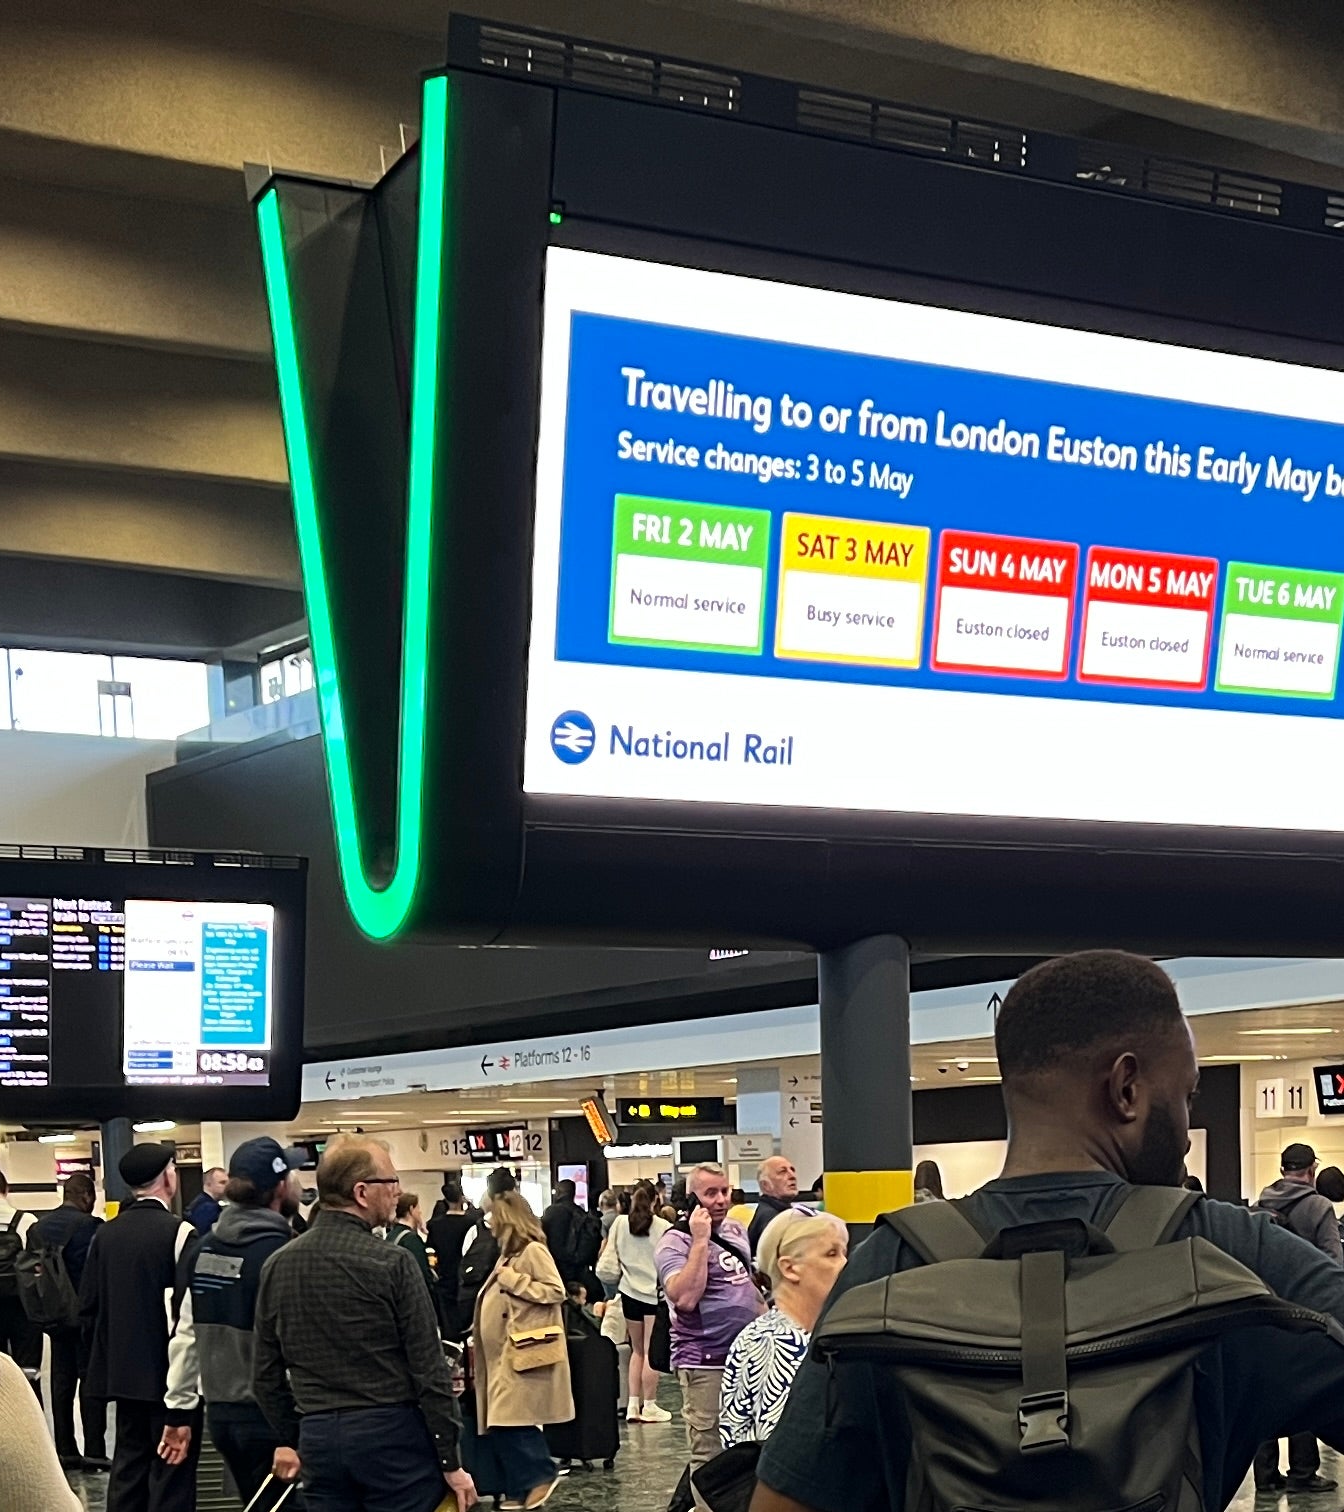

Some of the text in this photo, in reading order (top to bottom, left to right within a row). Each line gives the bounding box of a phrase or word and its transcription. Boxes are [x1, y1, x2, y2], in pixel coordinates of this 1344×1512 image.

[621, 367, 771, 433] Travelling
[781, 394, 813, 428] to
[820, 404, 852, 433] or
[858, 400, 927, 444] from
[936, 411, 1040, 458] London
[1047, 426, 1137, 471] Euston
[1145, 440, 1191, 477] this
[1197, 446, 1260, 494] Early
[1265, 456, 1322, 501] May
[618, 430, 914, 499] Service changes: 3 to 5 May
[632, 512, 754, 552] FRI 2 MAY
[797, 532, 914, 567] SAT 3 MAY
[949, 548, 1067, 584] SUN 4 MAY
[1090, 561, 1213, 598] MON 5 MAY
[630, 588, 746, 615] Normal service
[1236, 577, 1337, 610] TUE 6 MAY
[807, 605, 895, 628] Busy service
[956, 618, 1049, 641] Euston closed
[1101, 631, 1189, 653] Euston closed
[1234, 643, 1324, 664] Normal service
[610, 724, 793, 765] National Rail
[514, 1045, 591, 1069] Platforms 12 16
[1262, 1086, 1303, 1110] 11 11
[439, 1140, 469, 1156] 13 13
[525, 1134, 542, 1151] 12
